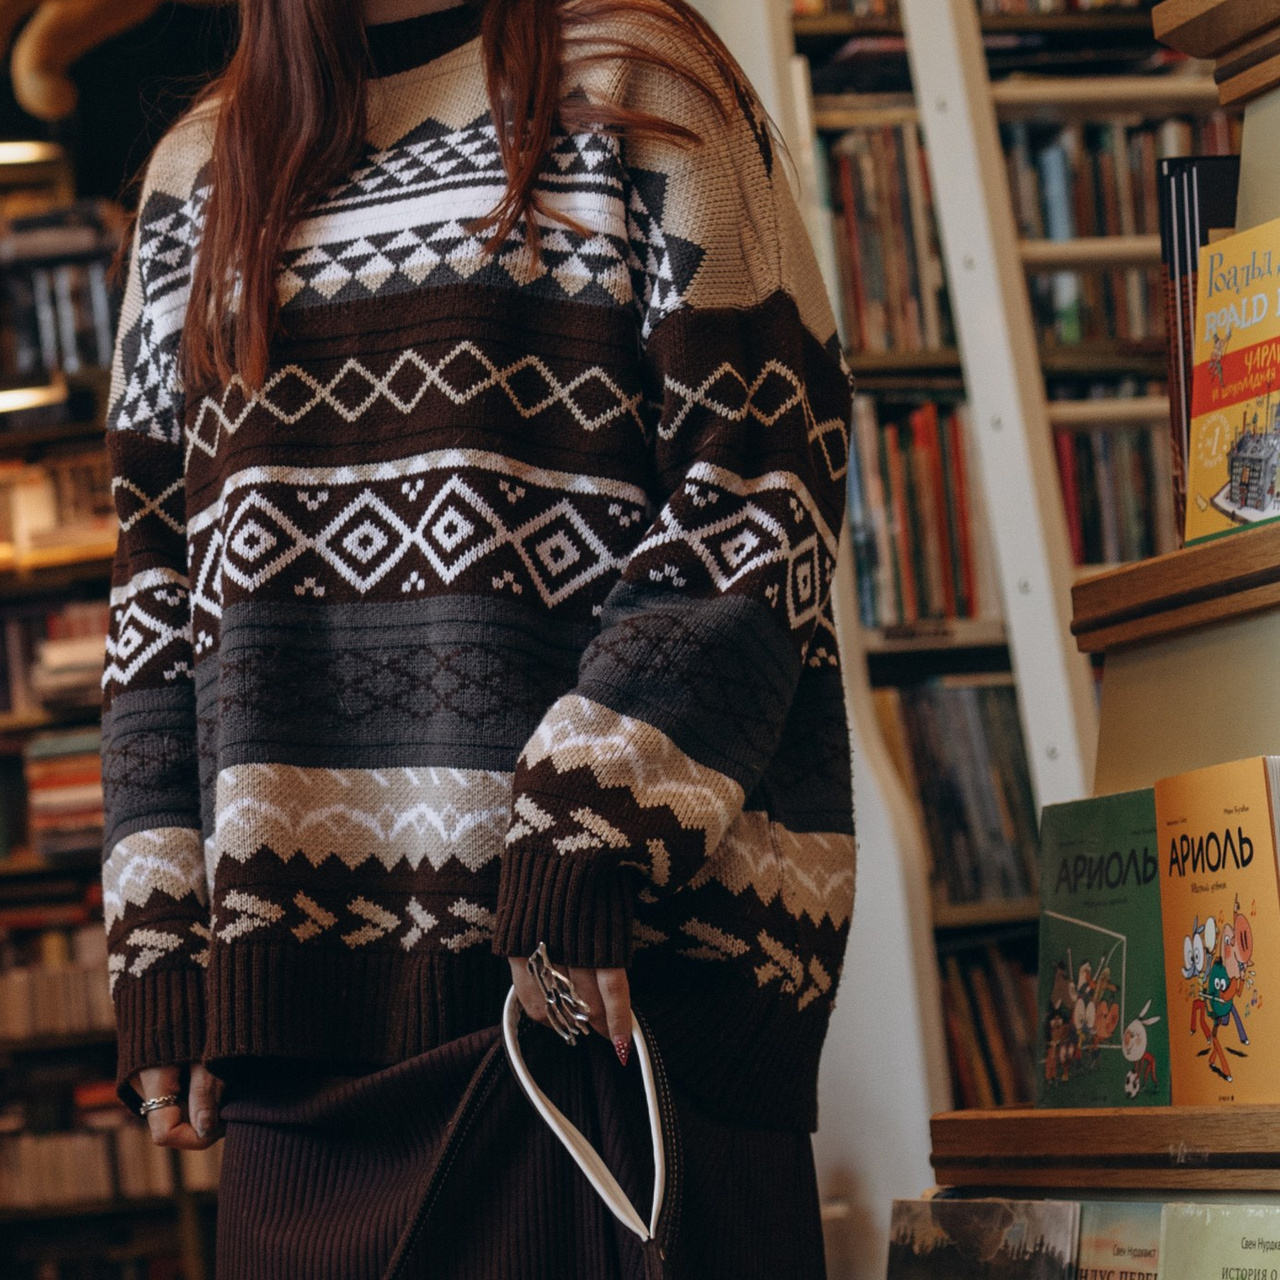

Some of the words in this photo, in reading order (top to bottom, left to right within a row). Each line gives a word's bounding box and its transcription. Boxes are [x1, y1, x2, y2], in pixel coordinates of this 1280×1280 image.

[1206, 249, 1272, 298] Роальд
[1204, 293, 1269, 342] ROALD
[1054, 845, 1158, 895] АРИОЛЬ
[1168, 825, 1254, 878] АРИОЛЬ
[1241, 1236, 1257, 1250] Свен
